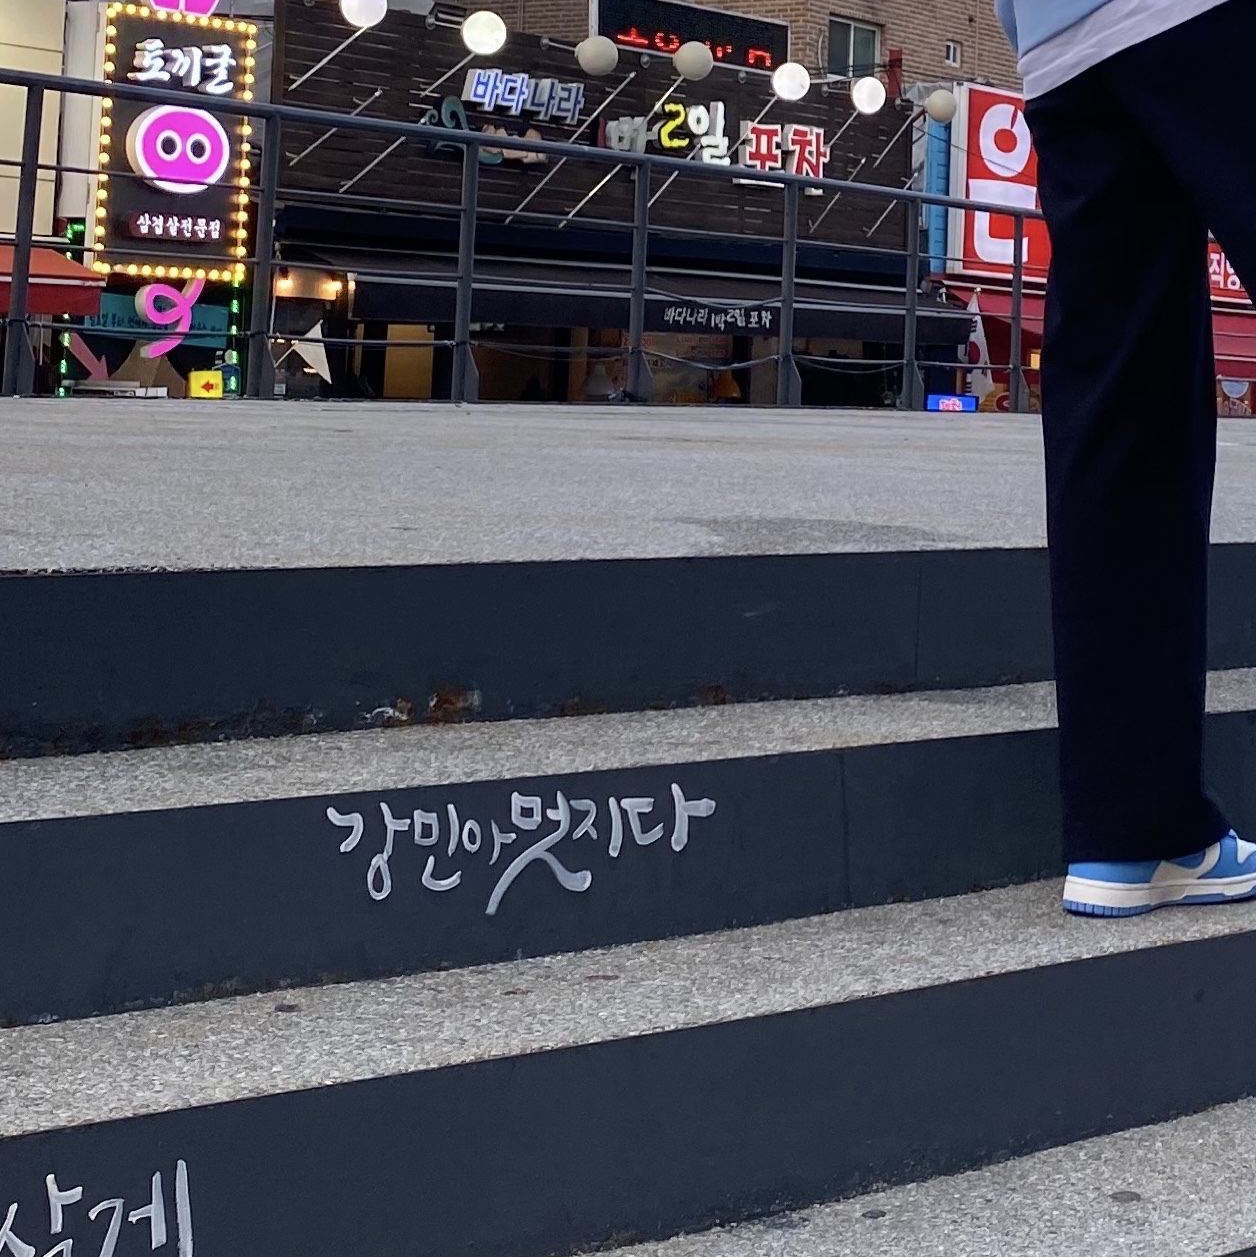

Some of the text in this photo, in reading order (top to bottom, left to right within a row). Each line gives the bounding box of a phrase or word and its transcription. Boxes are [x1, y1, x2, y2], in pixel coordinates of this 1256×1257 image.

[128, 38, 237, 94] 토끼굴
[466, 69, 585, 125] 바다나라
[663, 306, 709, 326] 바다나라
[747, 310, 773, 329] 포차
